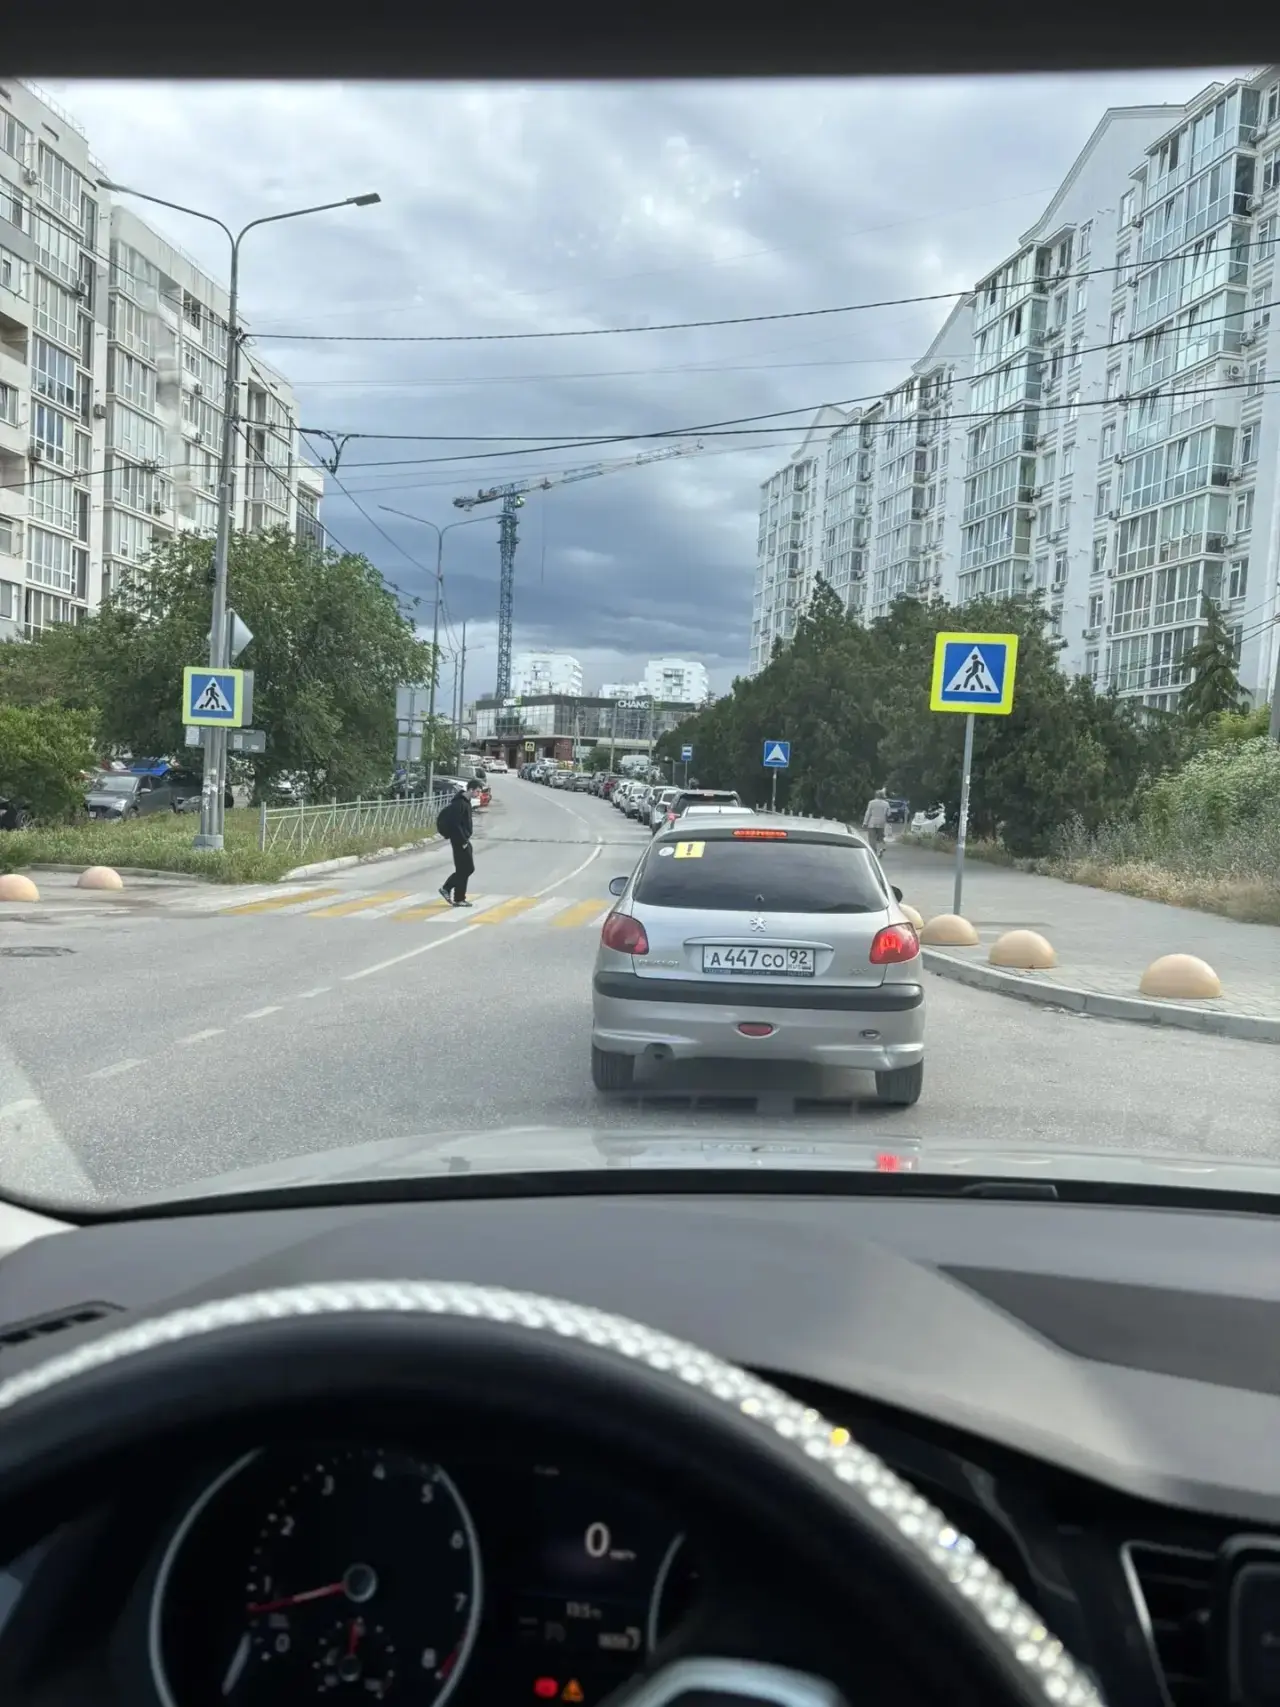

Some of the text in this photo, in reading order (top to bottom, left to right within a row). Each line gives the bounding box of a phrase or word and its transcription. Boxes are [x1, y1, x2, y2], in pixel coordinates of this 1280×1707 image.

[789, 950, 808, 964] 92
[280, 1514, 295, 1537] 2
[449, 1530, 464, 1550] 6
[584, 1520, 611, 1559] 0
[263, 1575, 272, 1594] 1
[452, 1592, 468, 1613] 7
